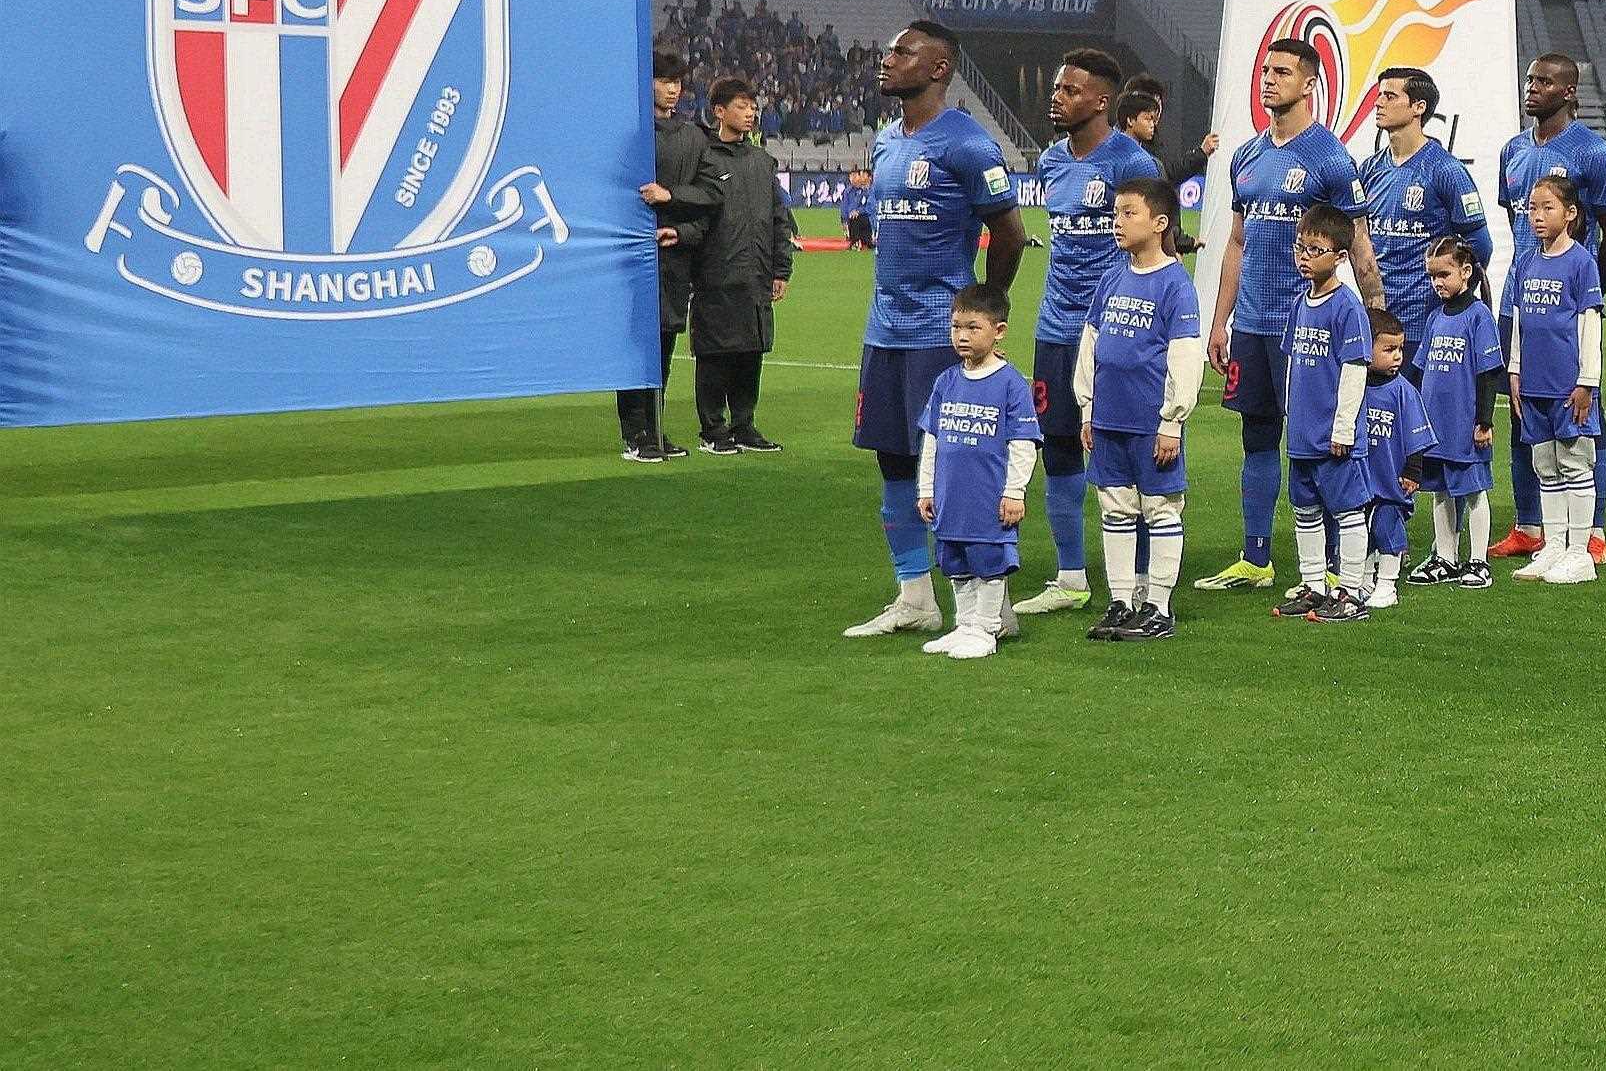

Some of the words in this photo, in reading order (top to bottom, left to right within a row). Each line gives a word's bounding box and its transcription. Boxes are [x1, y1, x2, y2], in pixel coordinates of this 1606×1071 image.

[394, 138, 440, 209] SINCE
[429, 86, 463, 137] 1993
[239, 263, 436, 304] SHANGHAI
[1108, 296, 1156, 316] 中国平安
[1103, 310, 1153, 330] PINGAN
[941, 401, 1000, 422] 中国平安
[939, 418, 997, 437] PINGAN
